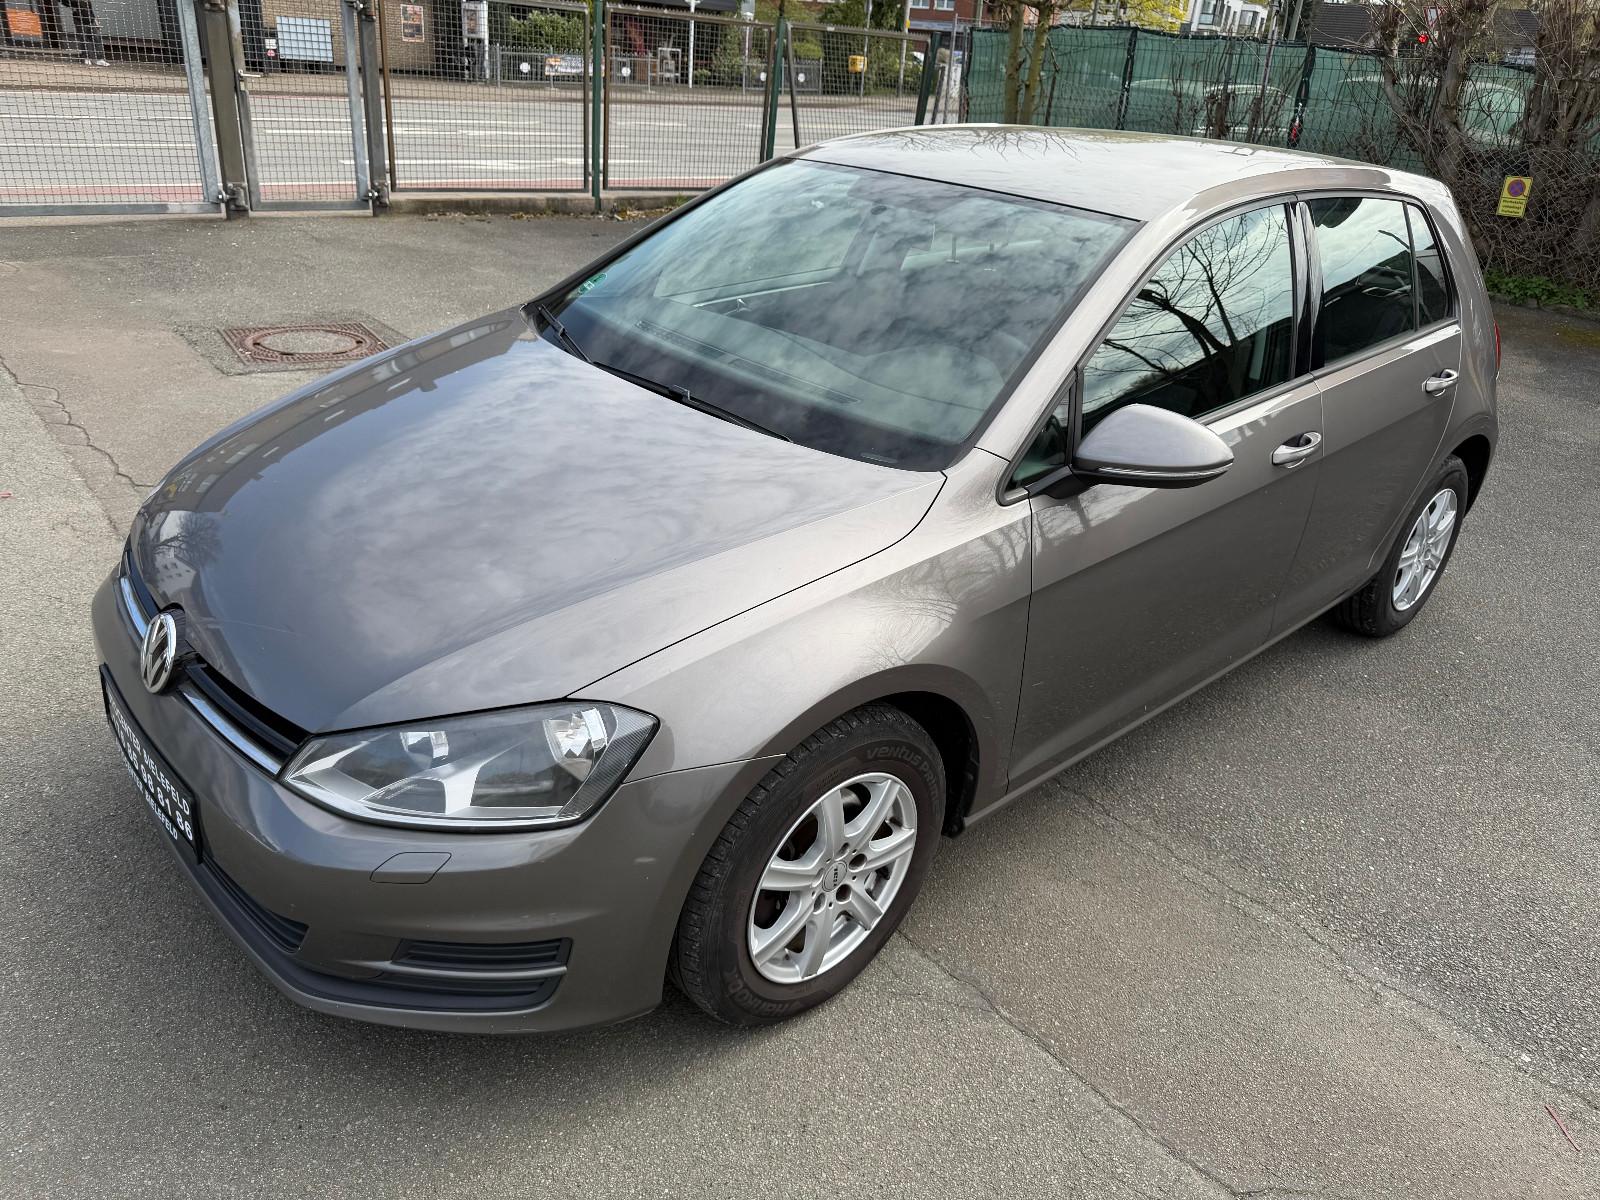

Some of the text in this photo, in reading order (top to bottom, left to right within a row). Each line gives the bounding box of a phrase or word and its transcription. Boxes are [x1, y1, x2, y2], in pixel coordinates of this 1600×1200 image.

[143, 748, 190, 815] BIELEFELD
[157, 787, 172, 816] 81
[176, 810, 193, 841] 86
